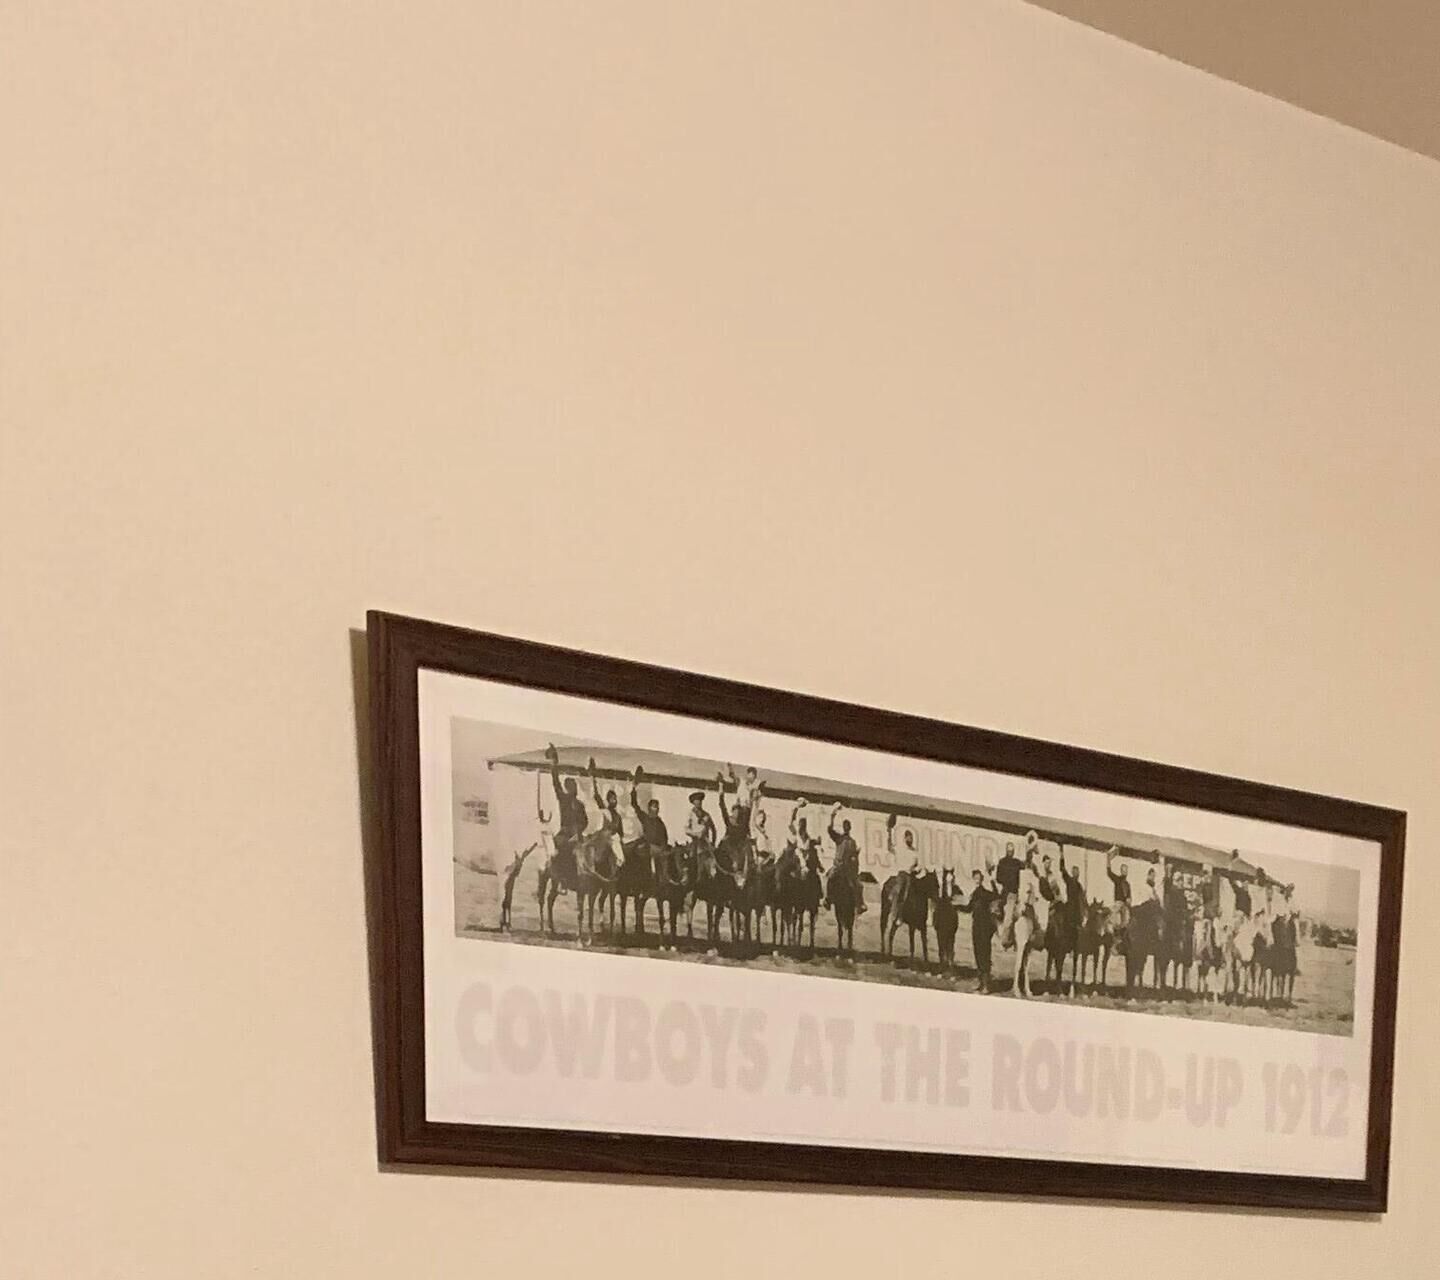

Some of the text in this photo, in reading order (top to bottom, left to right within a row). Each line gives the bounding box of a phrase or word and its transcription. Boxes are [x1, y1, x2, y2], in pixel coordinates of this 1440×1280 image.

[455, 980, 1349, 1138] COWBOYS AT THE ROUND-UP 1912
